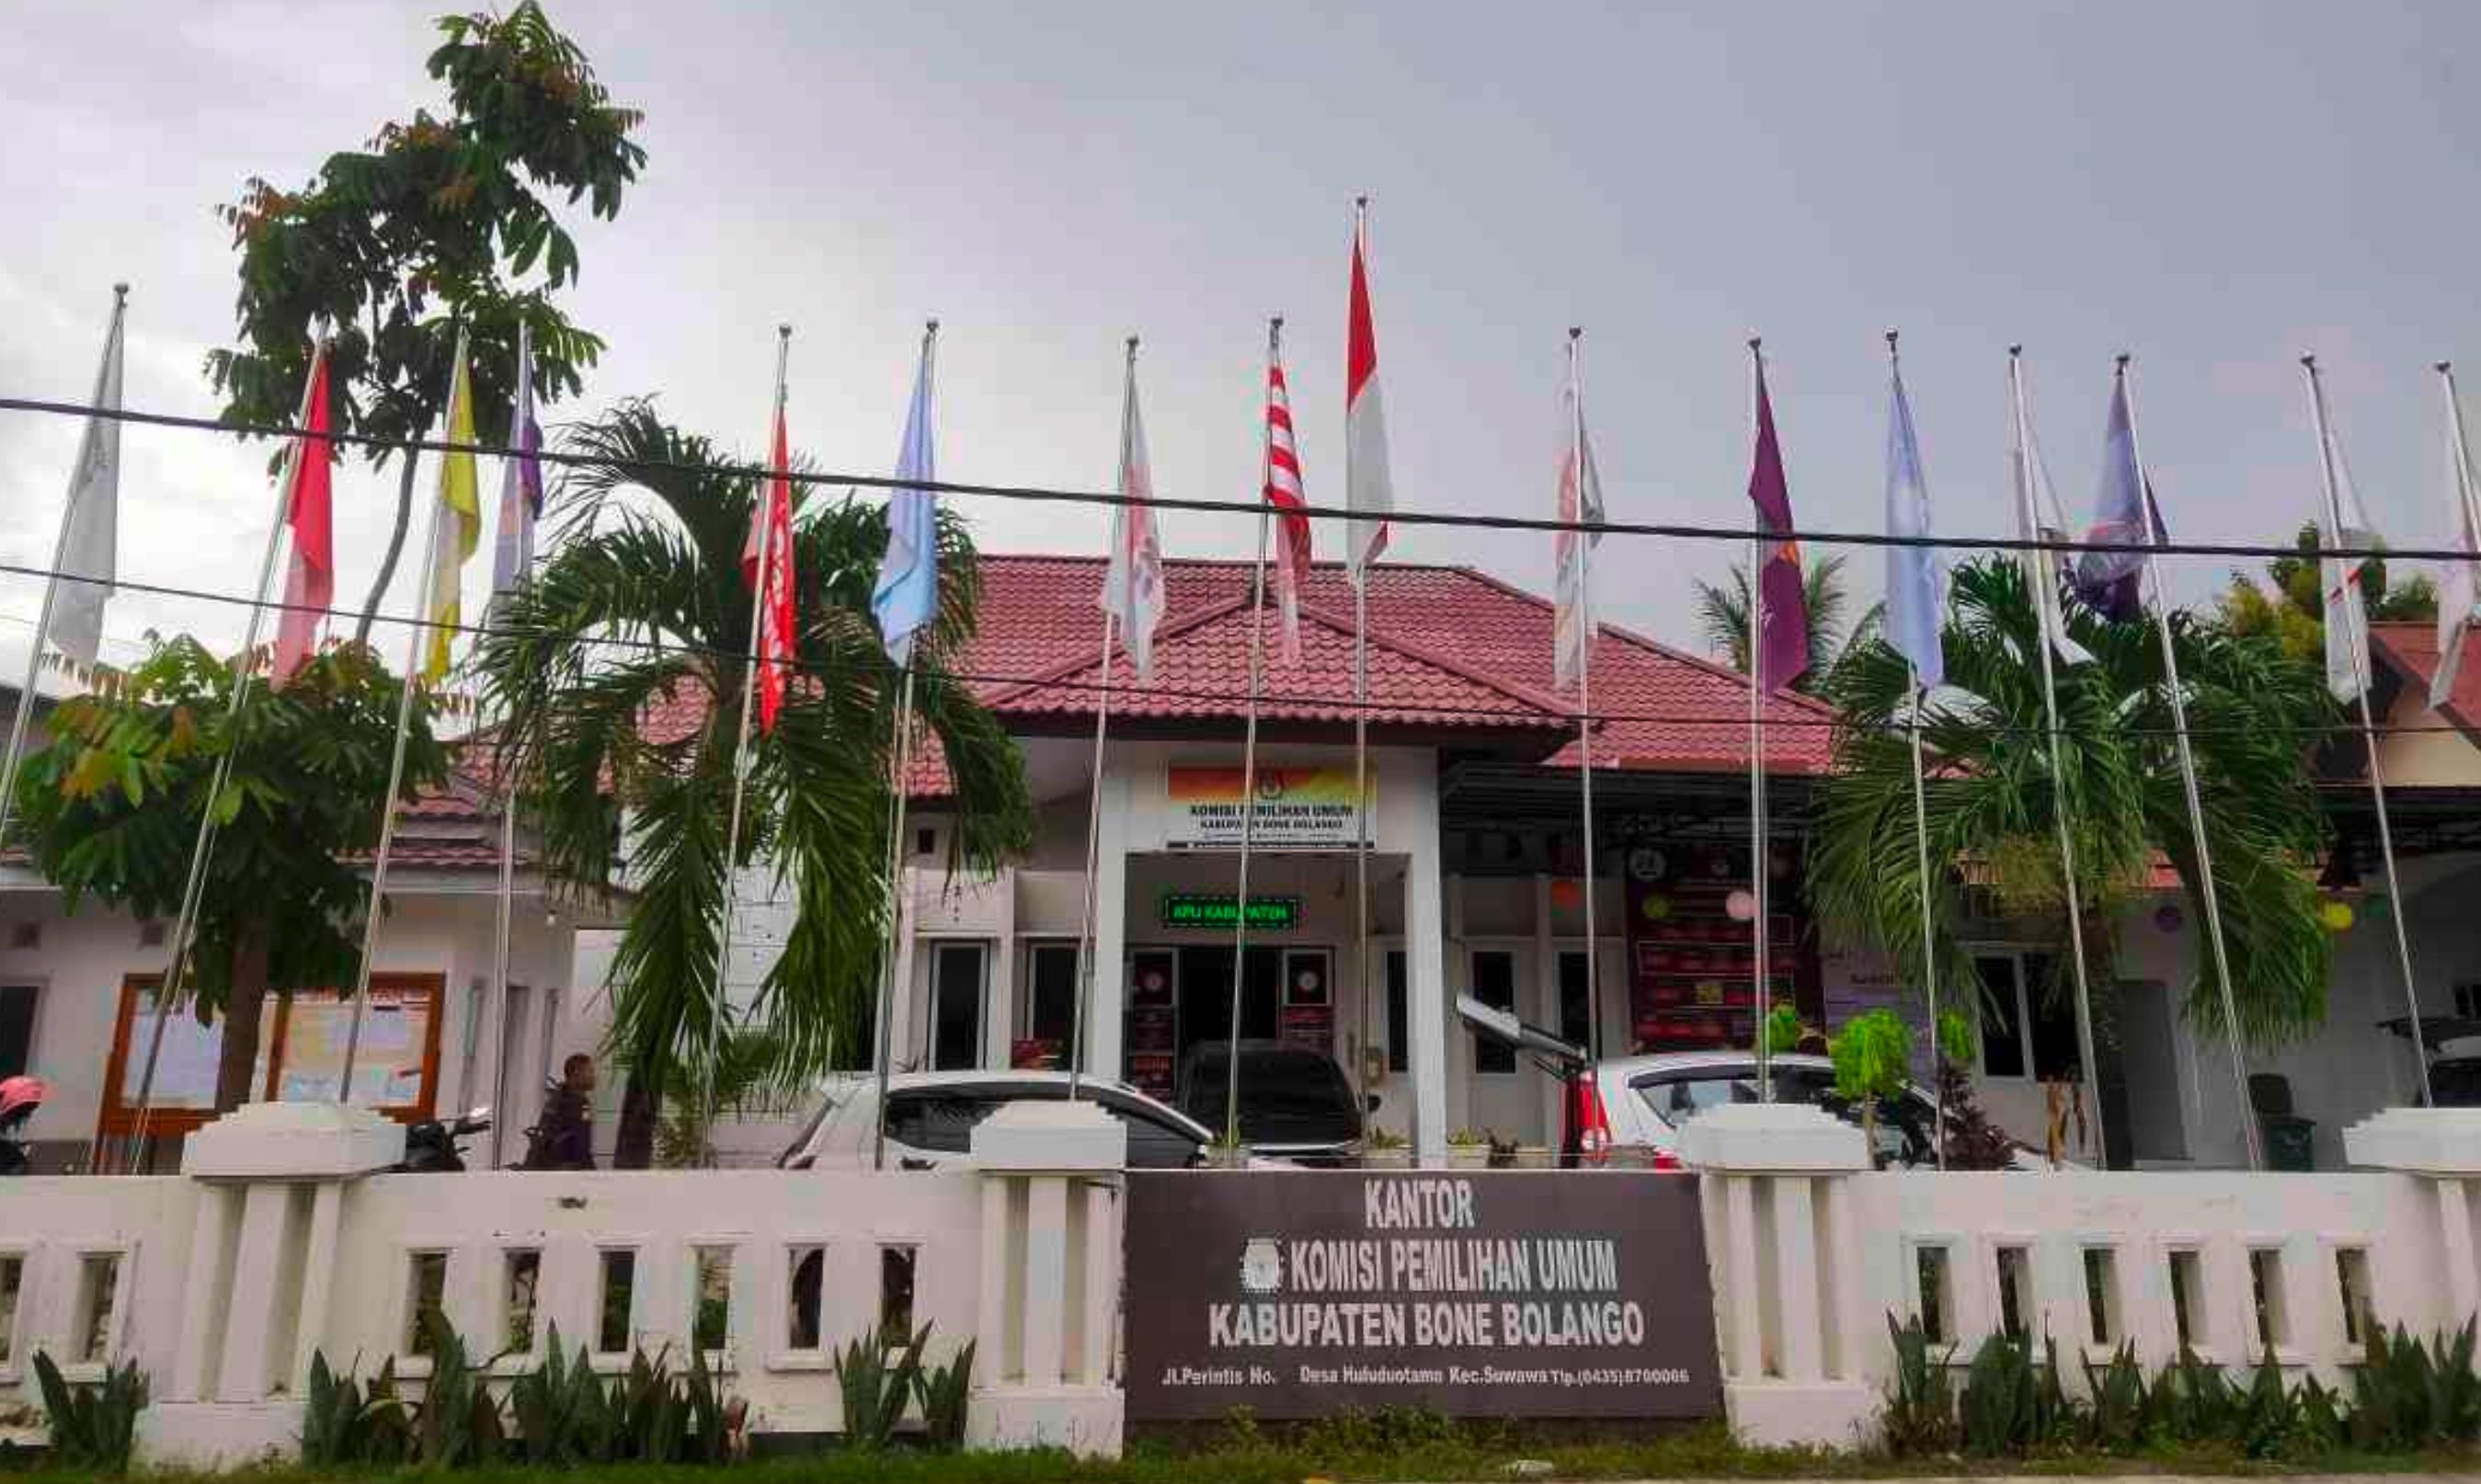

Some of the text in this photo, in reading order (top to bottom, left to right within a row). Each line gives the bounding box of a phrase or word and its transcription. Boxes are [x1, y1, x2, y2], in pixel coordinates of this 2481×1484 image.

[1190, 805, 1238, 816] KOMISI
[1200, 818, 1261, 828] KABUPAN
[1173, 905, 1202, 919] KPU
[1365, 1179, 1475, 1228] KANTOR
[1291, 1239, 1618, 1291] KOMISI PEMILIHAN UMUM
[1209, 1301, 1645, 1346] KABUPATEN BONE BOLANGO
[1249, 1365, 1276, 1385] No.
[1300, 1364, 1339, 1383] Desa
